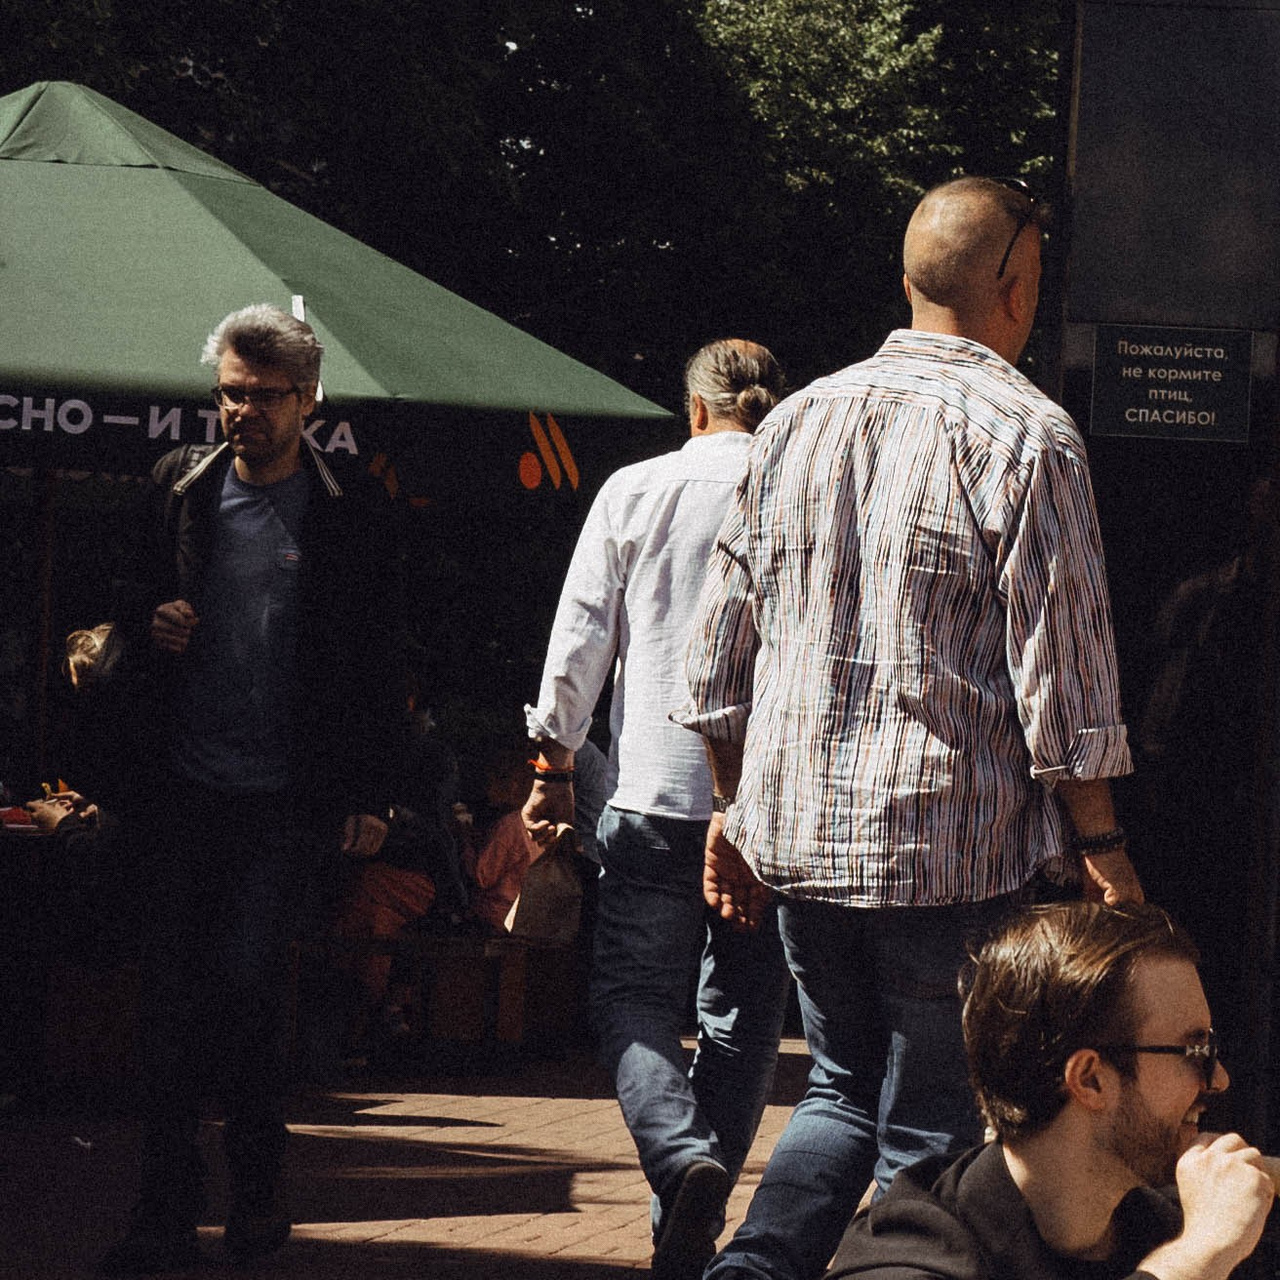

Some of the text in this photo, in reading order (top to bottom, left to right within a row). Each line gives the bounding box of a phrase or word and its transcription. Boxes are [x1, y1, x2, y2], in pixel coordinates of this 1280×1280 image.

[1122, 366, 1222, 382] не кормите
[148, 405, 183, 440] И
[1125, 407, 1216, 425] СПАСИБО!
